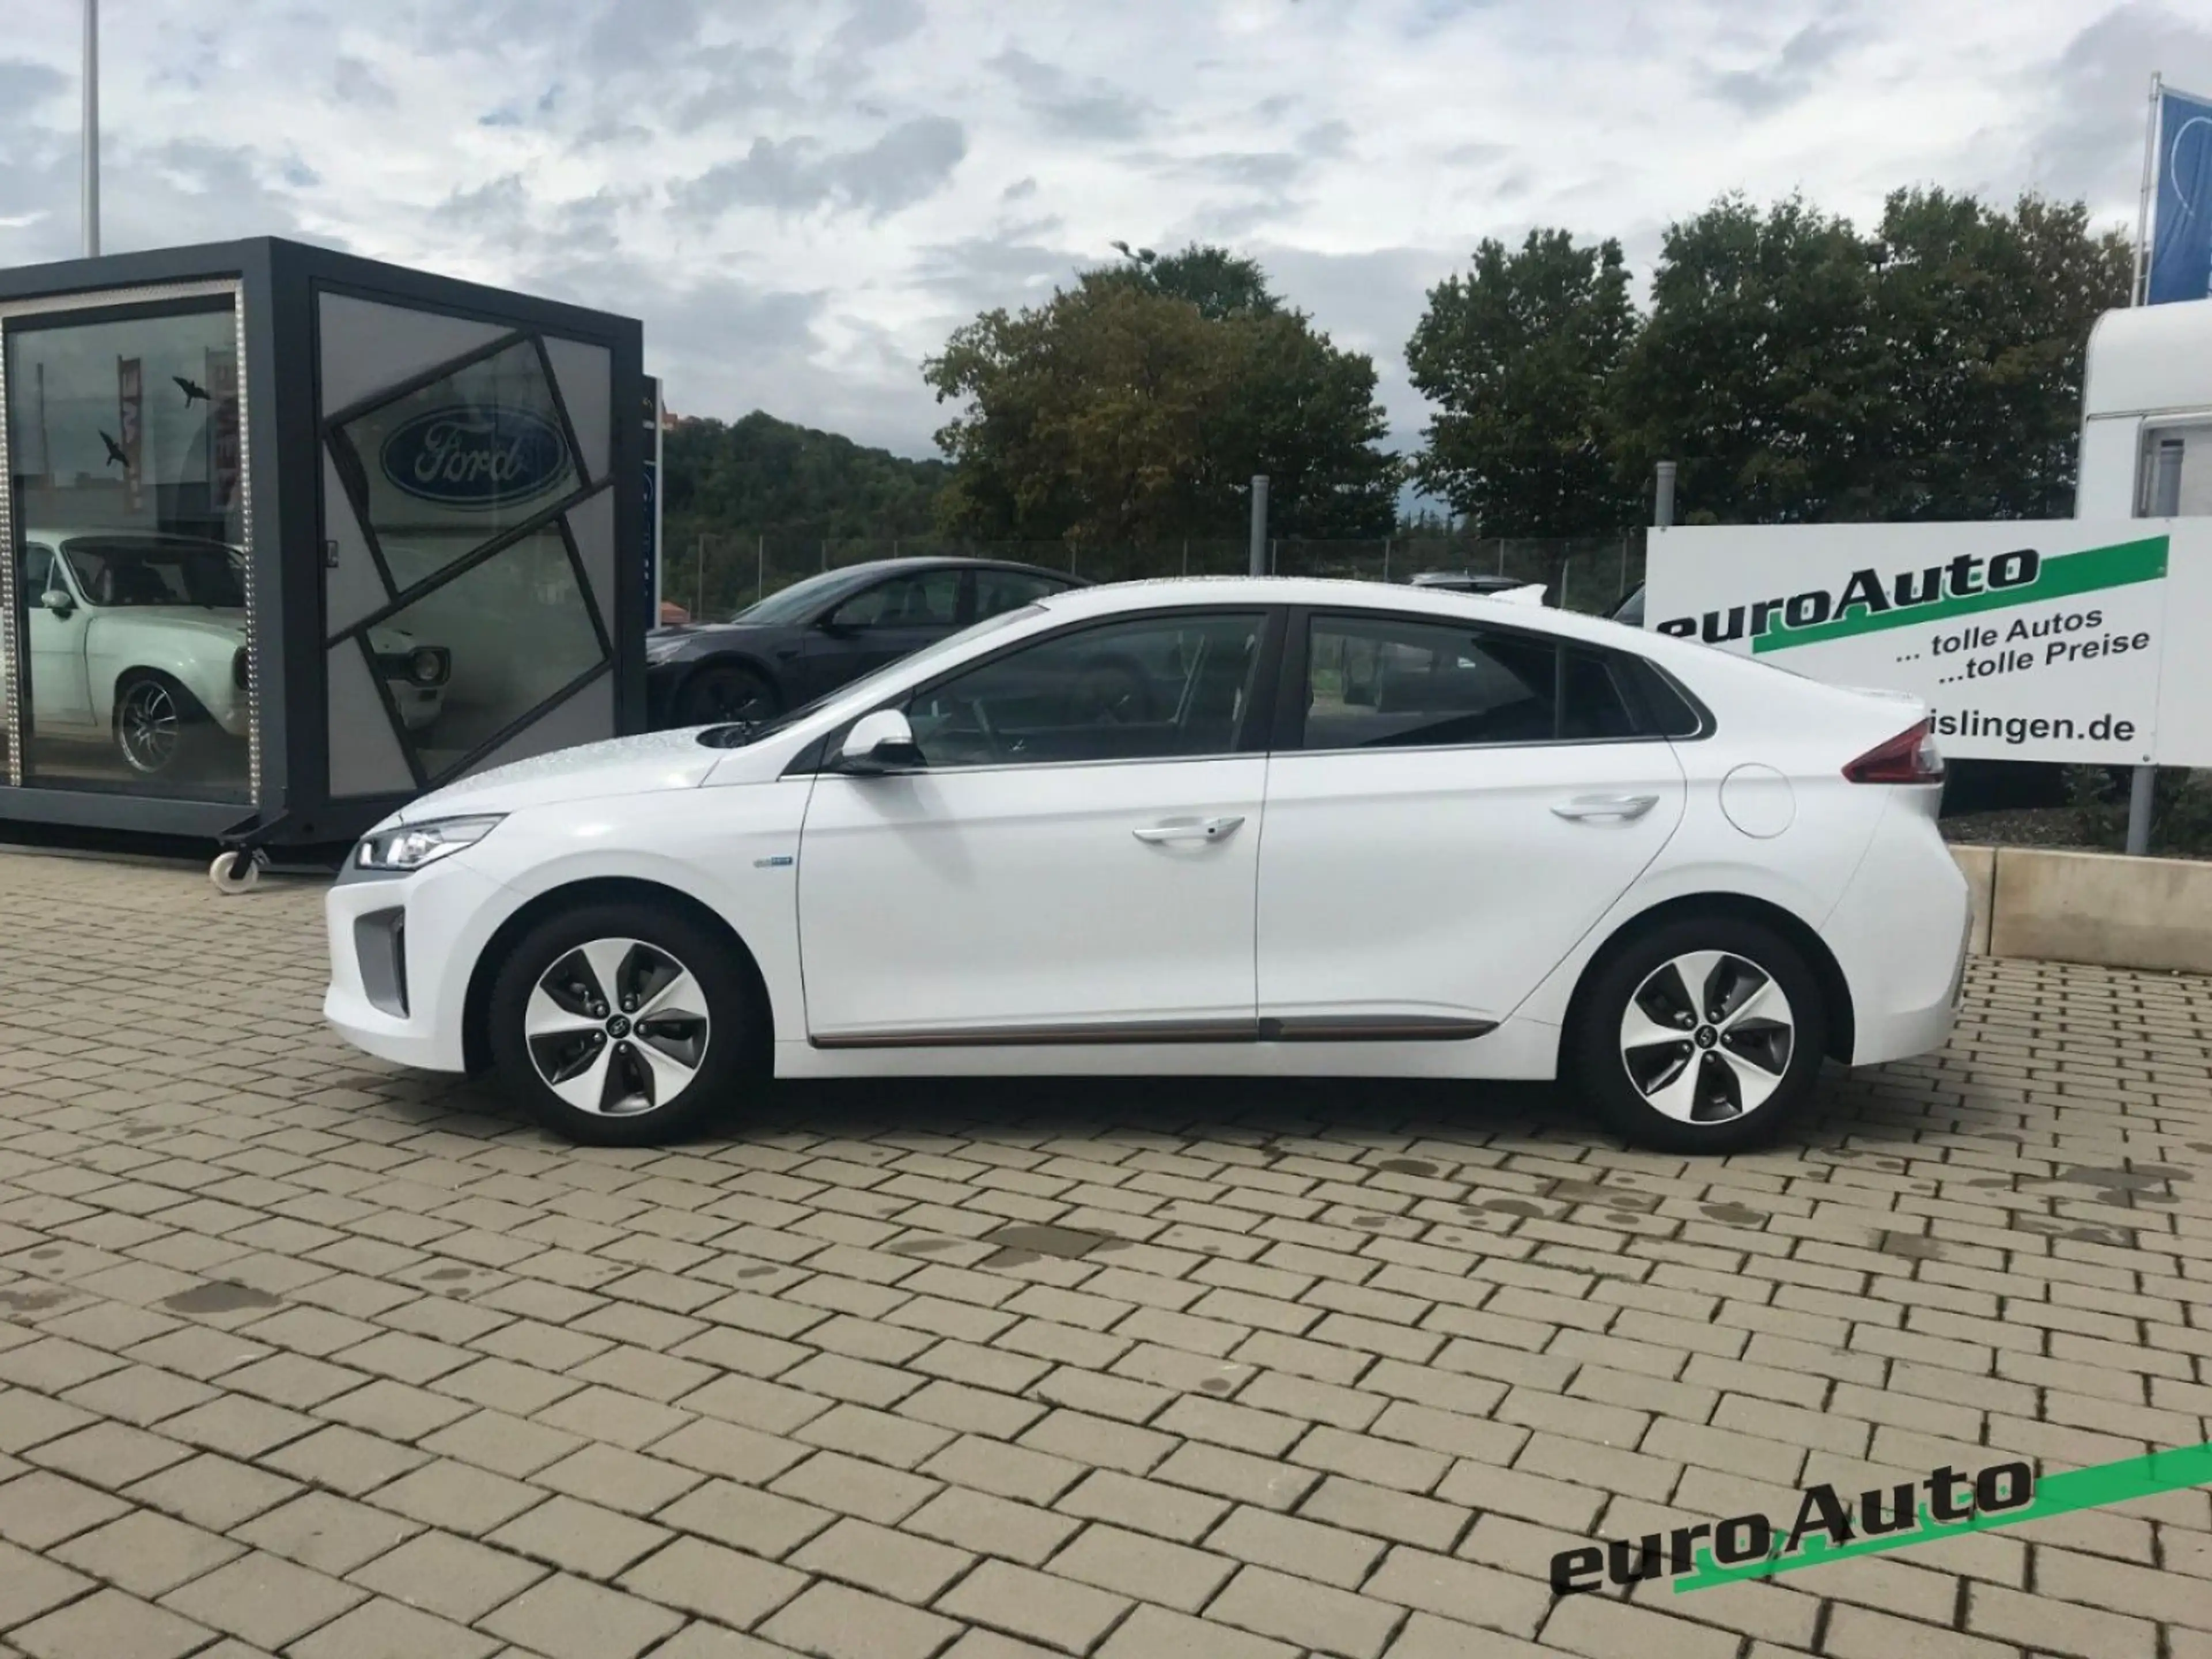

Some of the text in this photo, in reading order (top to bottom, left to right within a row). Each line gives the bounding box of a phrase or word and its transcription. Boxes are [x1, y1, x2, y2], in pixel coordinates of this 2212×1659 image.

[414, 421, 524, 482] Ford
[1657, 548, 2040, 644] euroAuto
[1931, 627, 1998, 657] tolle
[2005, 608, 2103, 642] Autos
[2045, 631, 2150, 665] Preise
[1930, 709, 2136, 745] islingen.de
